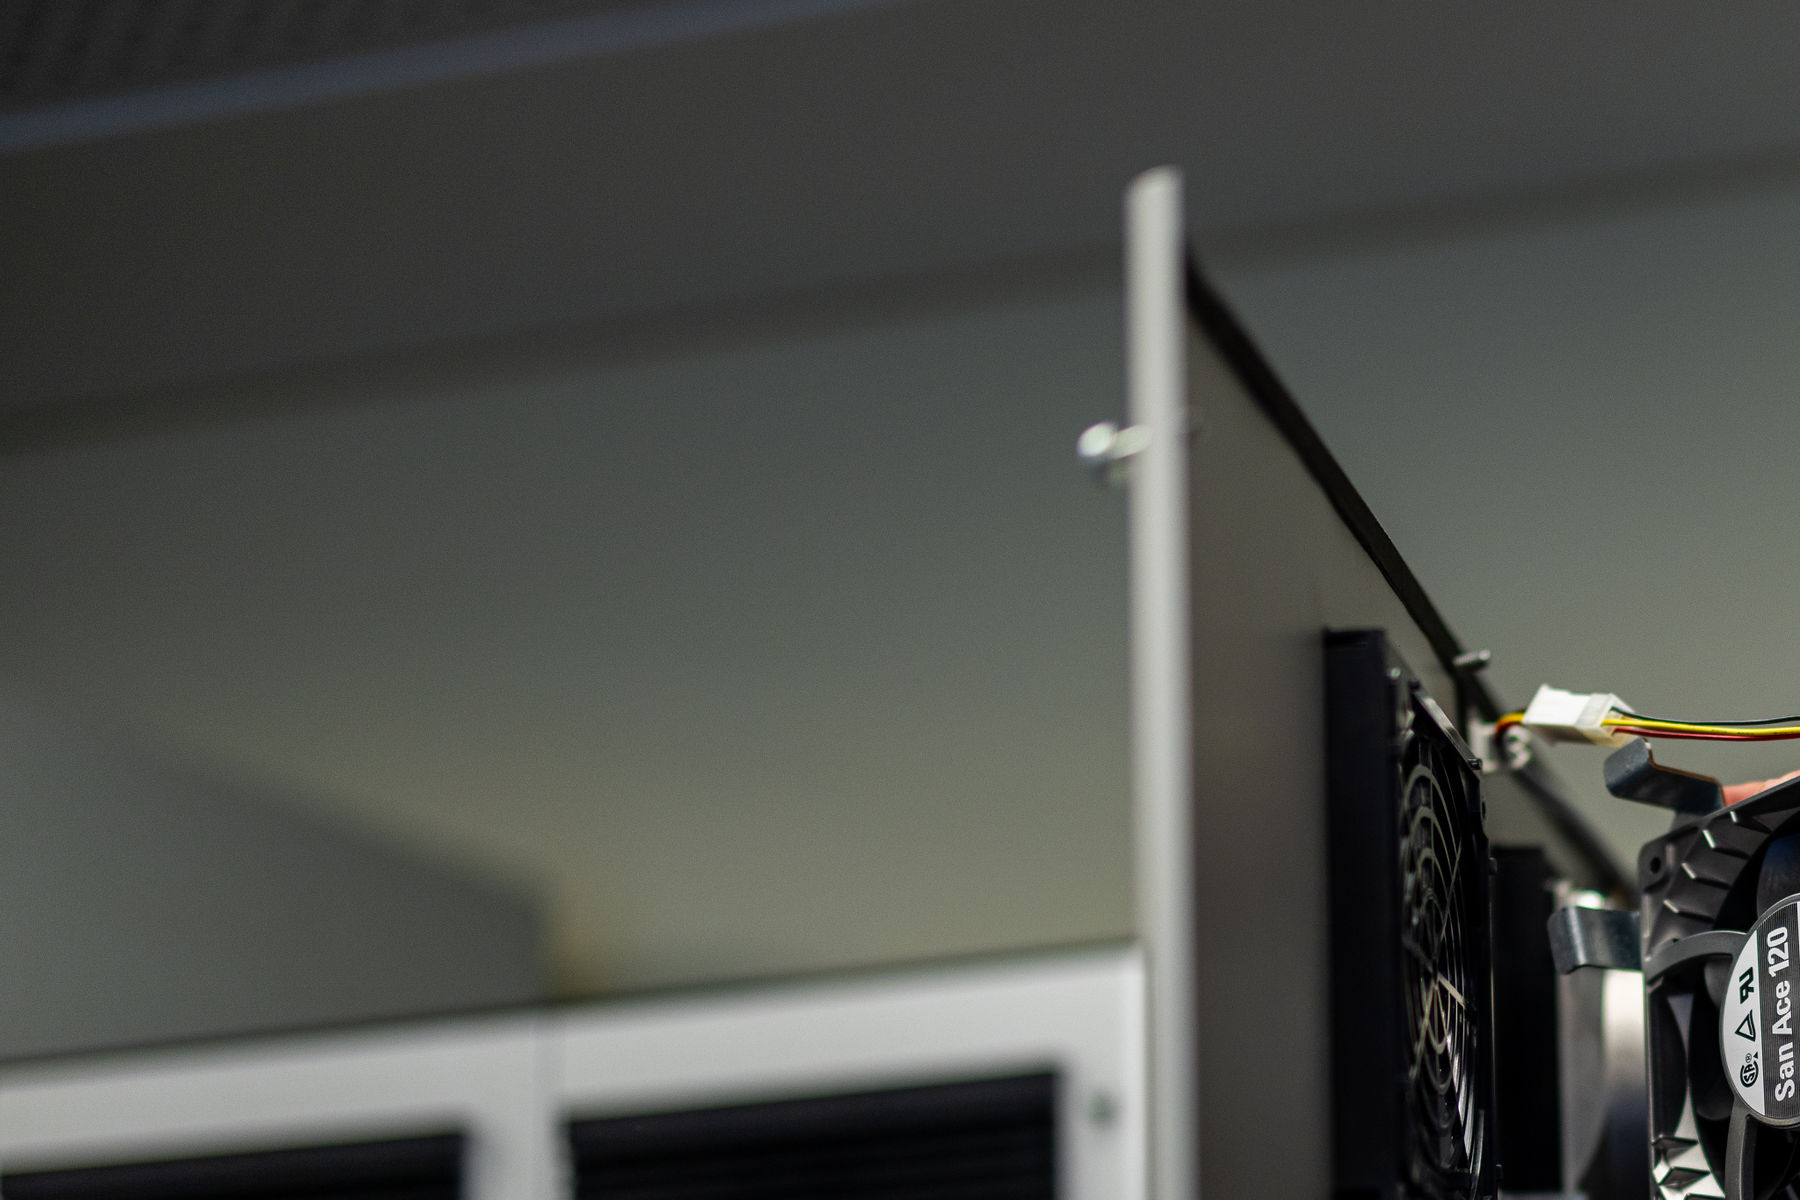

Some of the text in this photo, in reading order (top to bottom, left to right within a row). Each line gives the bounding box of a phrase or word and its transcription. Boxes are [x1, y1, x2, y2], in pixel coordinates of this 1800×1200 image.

[1767, 926, 1794, 1102] San Ace 120
